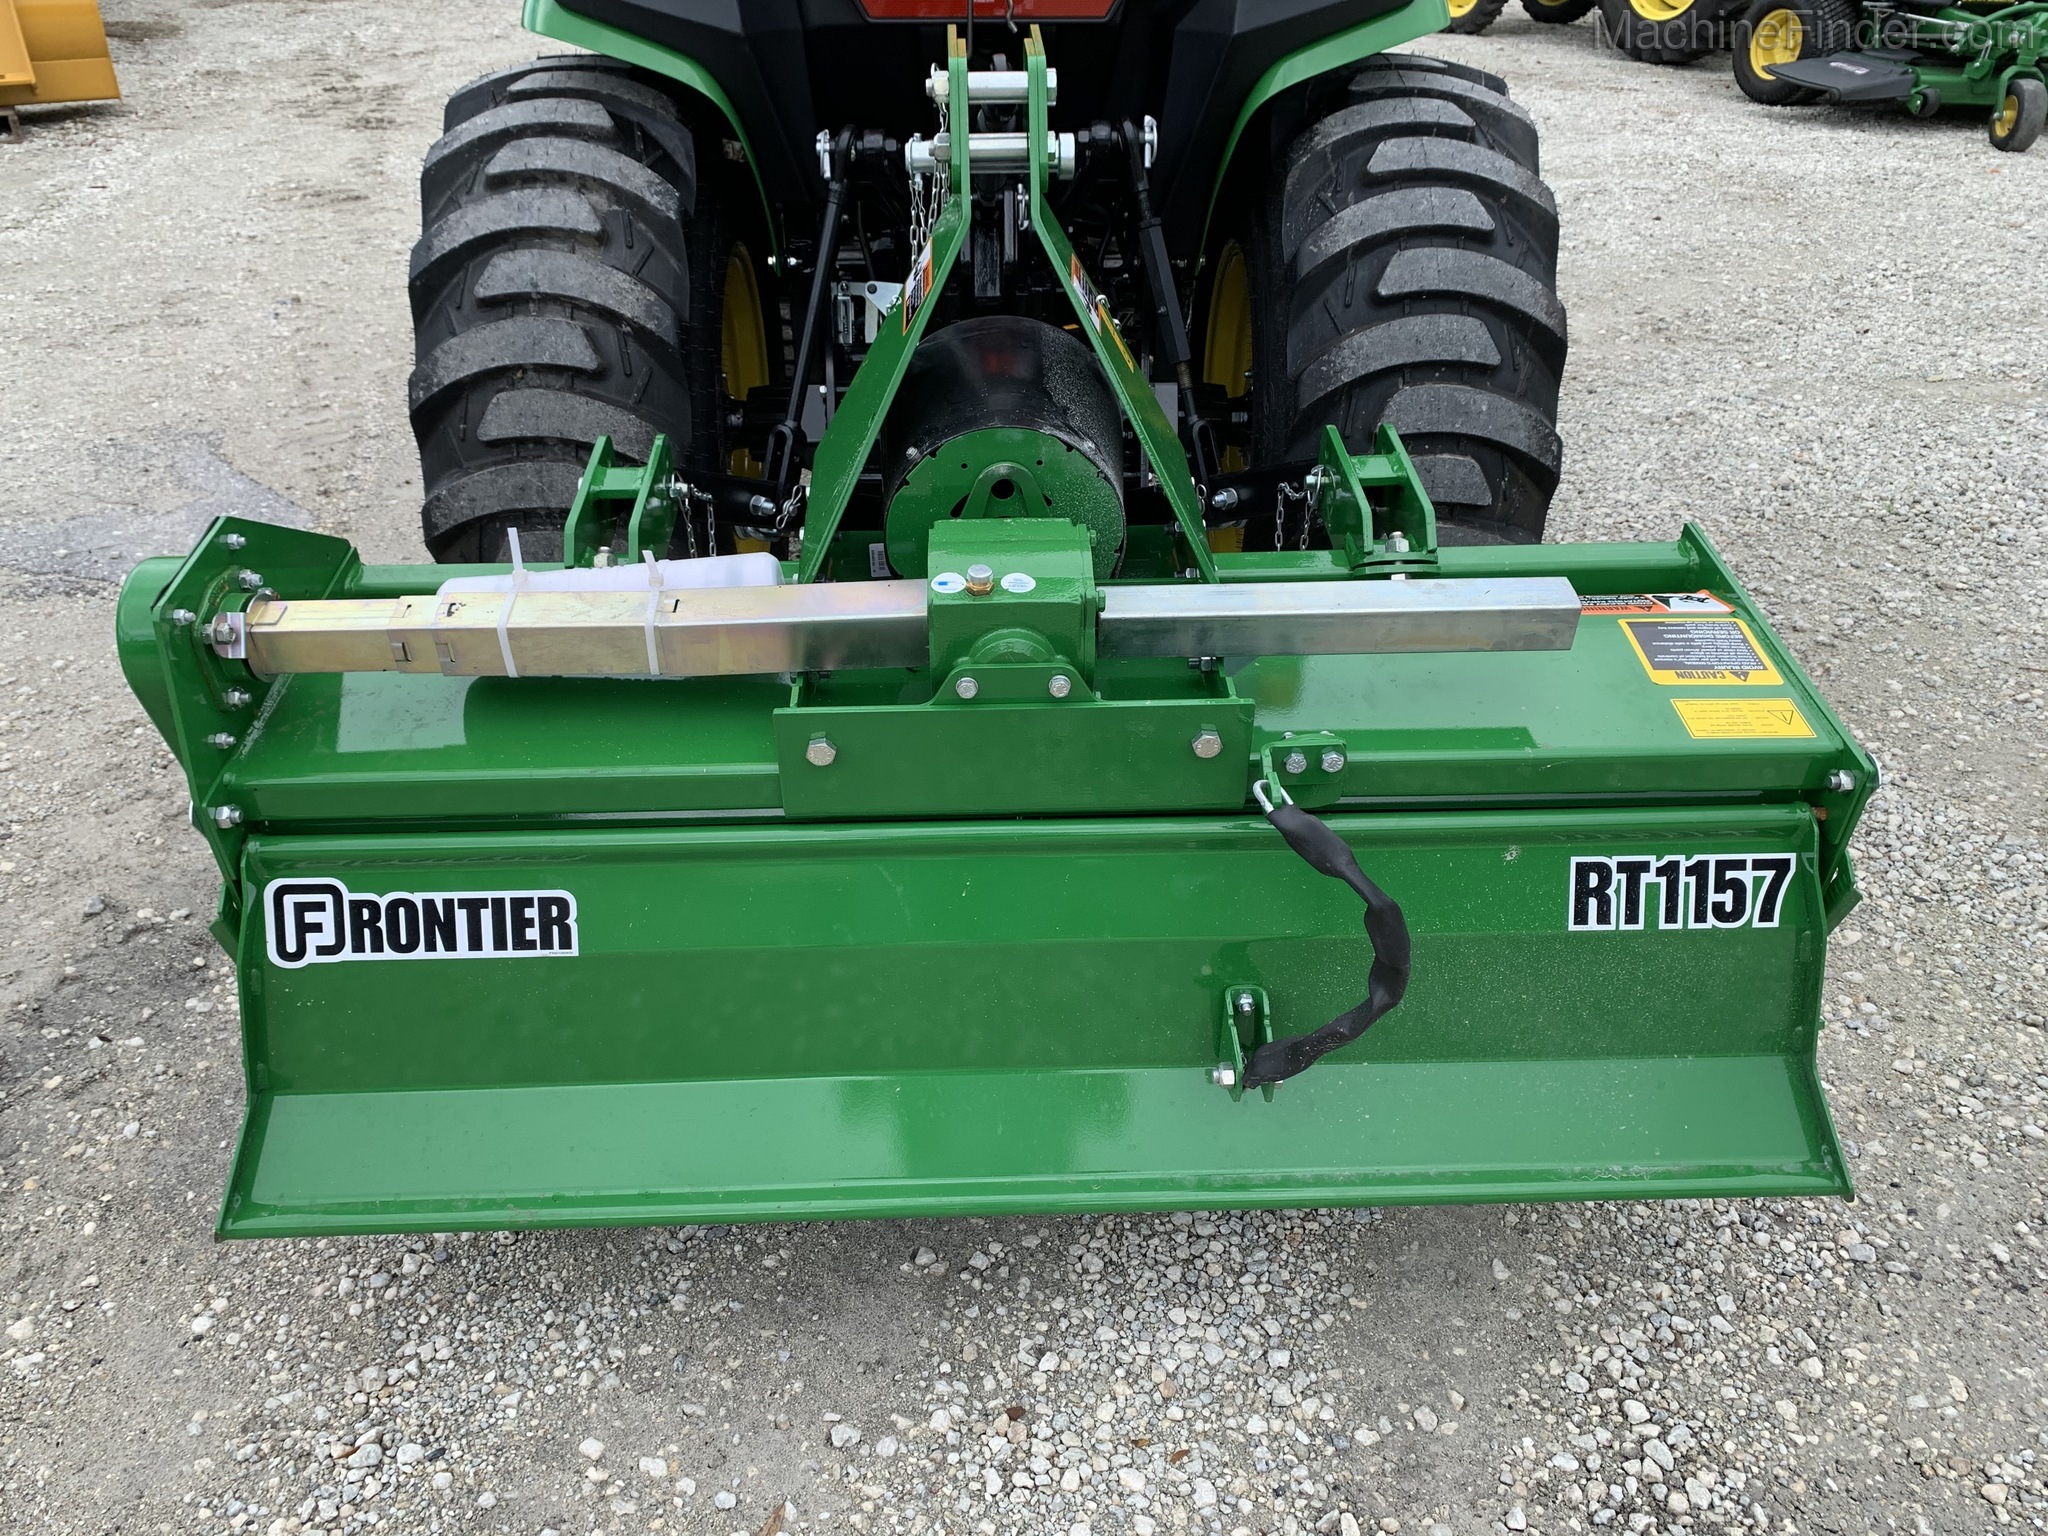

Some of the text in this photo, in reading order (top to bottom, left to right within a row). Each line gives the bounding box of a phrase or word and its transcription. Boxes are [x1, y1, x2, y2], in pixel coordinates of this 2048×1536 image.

[1674, 671, 1726, 680] CAUTION
[273, 884, 572, 962] FRONTIER
[1573, 858, 1791, 926] RT1157
